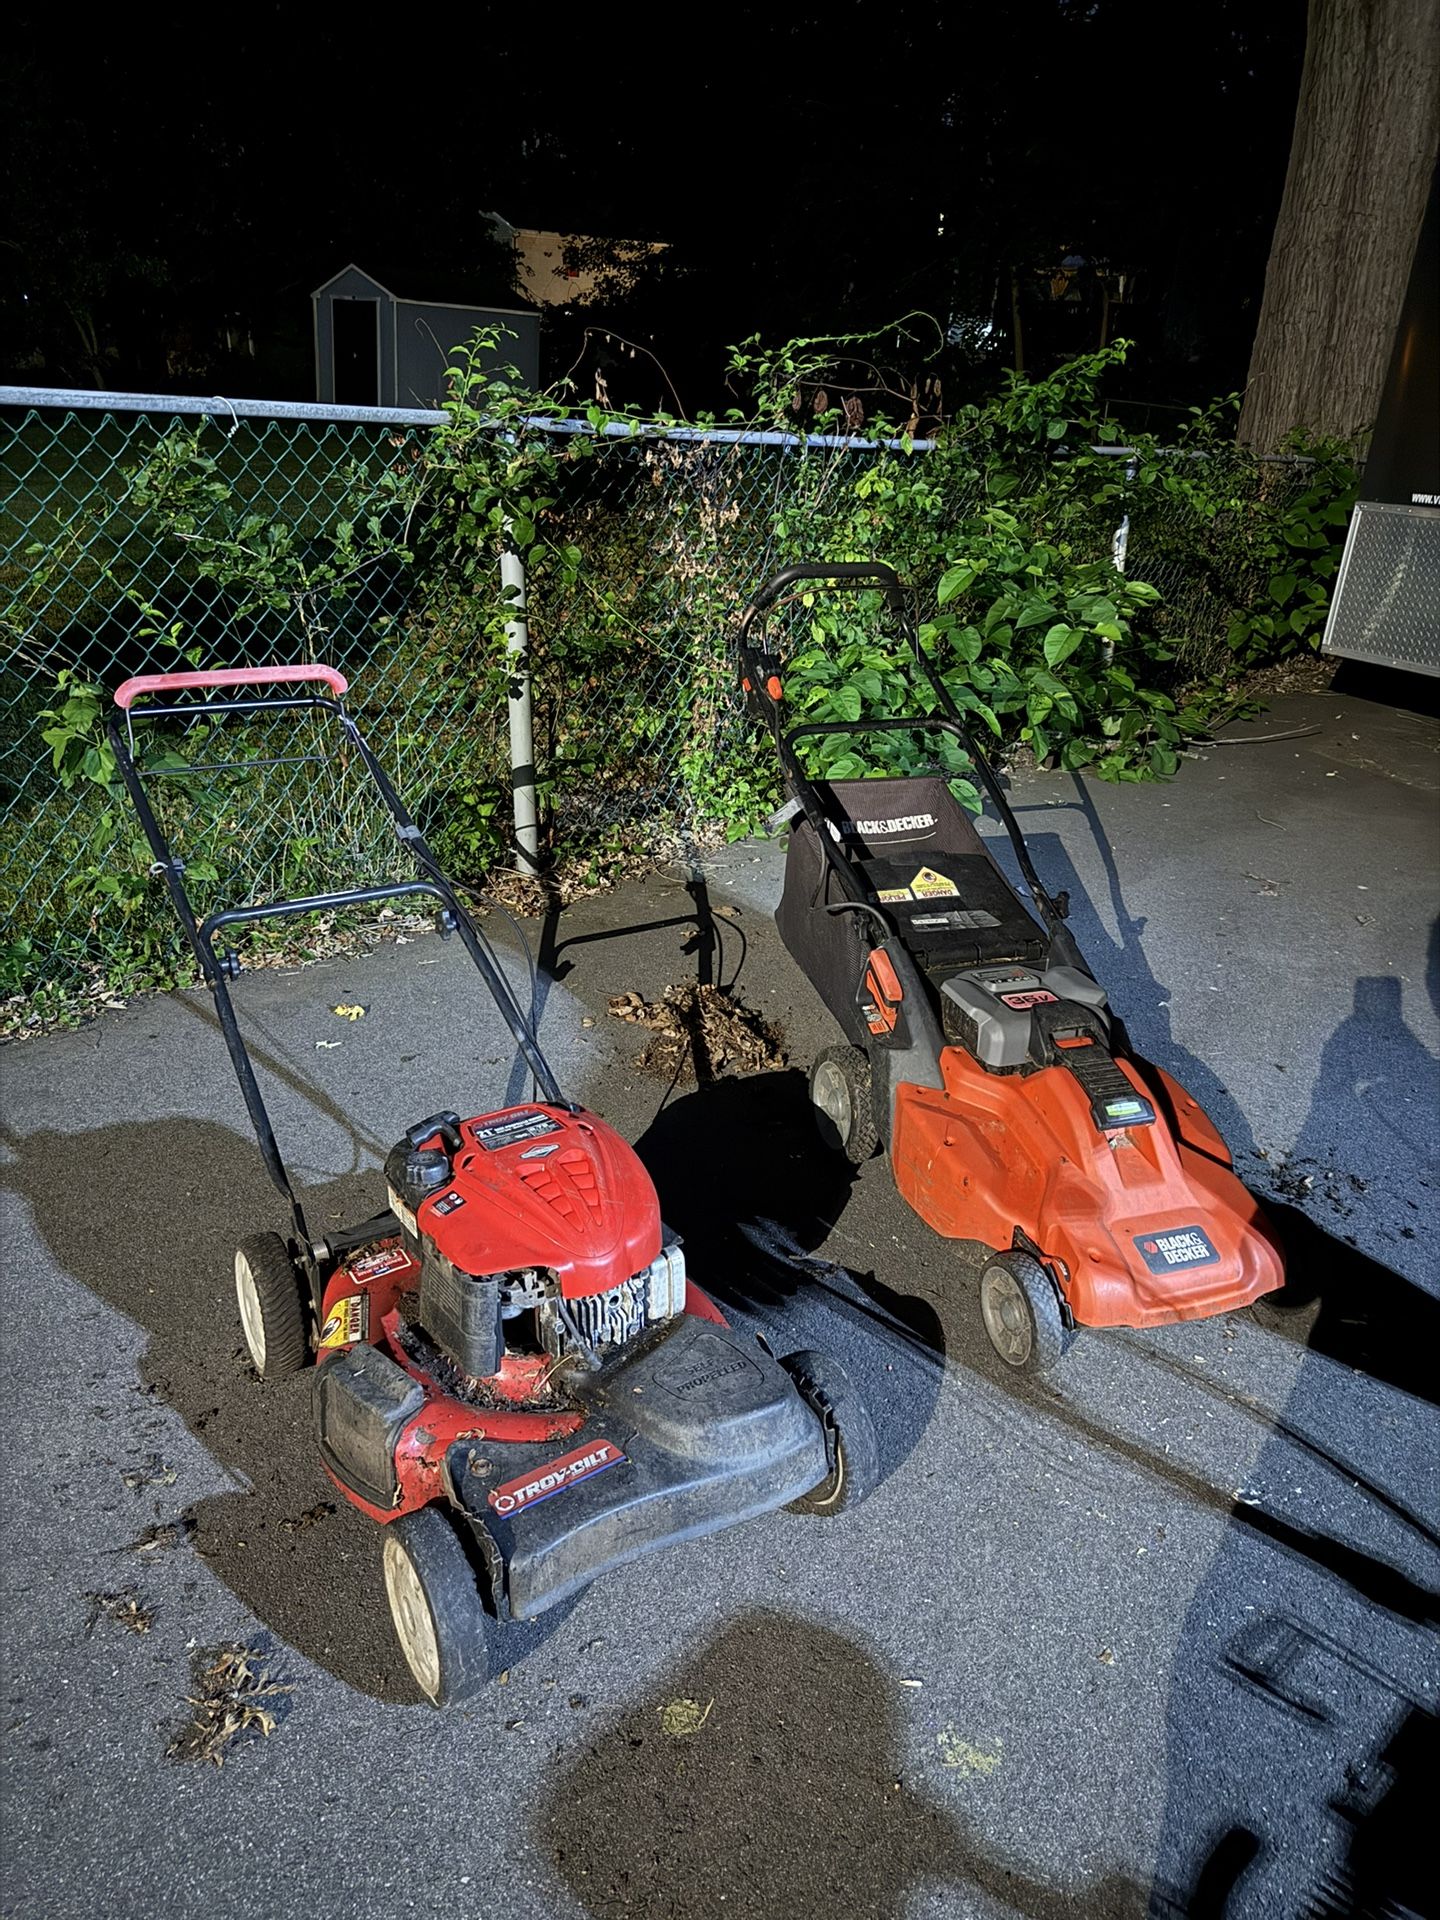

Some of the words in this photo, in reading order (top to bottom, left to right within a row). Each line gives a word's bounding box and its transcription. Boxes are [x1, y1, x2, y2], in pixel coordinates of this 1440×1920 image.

[922, 889, 953, 897] DANGER
[1163, 1246, 1210, 1265] DECKER
[349, 1302, 361, 1334] DANGER
[676, 1361, 748, 1394] PROPELLED
[684, 1357, 716, 1376] SELF
[513, 1445, 611, 1503] TROY-BILT
